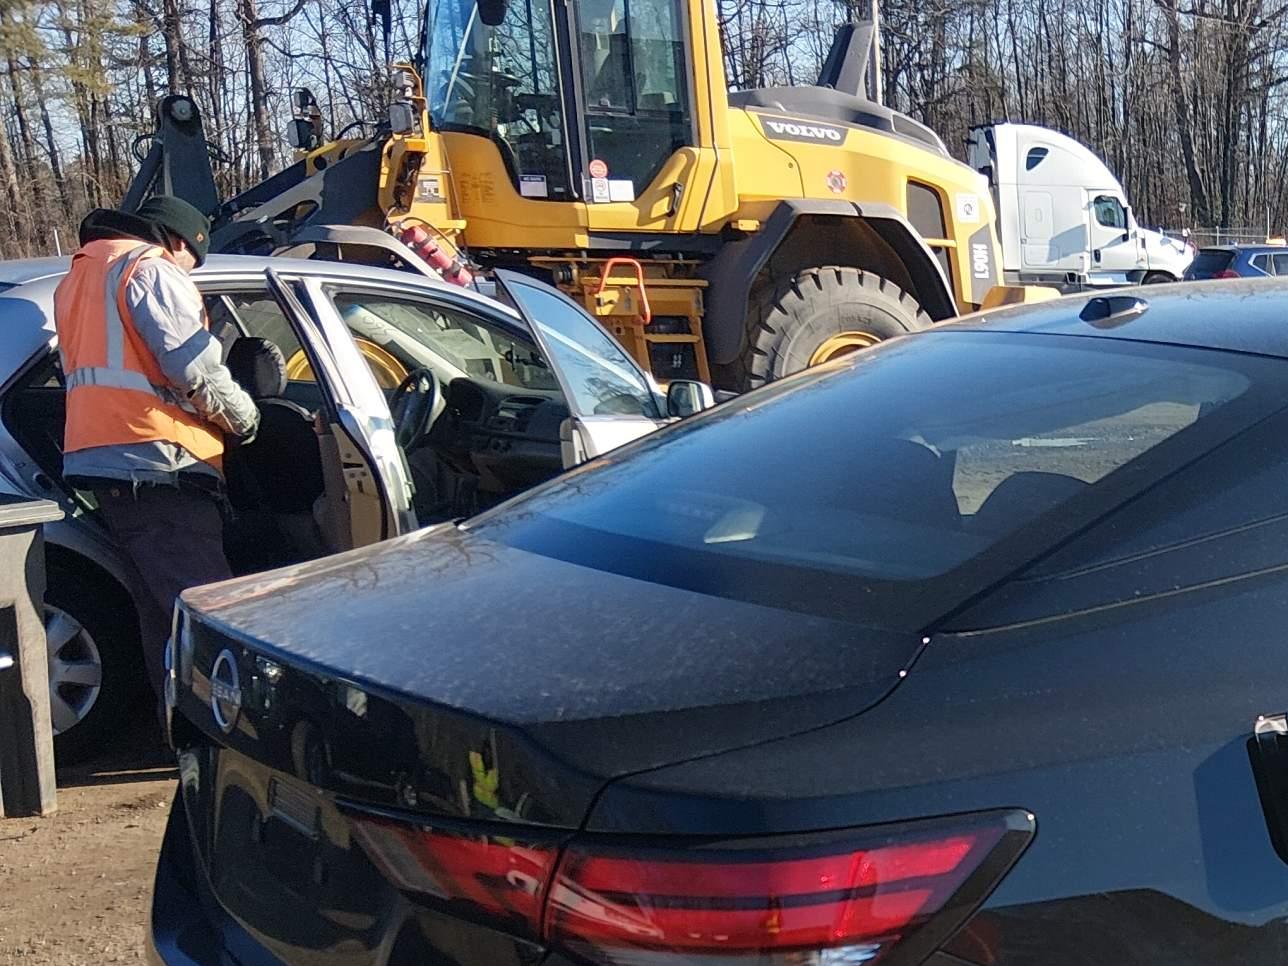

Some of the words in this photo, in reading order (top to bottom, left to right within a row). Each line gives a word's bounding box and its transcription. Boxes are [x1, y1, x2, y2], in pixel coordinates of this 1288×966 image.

[766, 121, 841, 140] VOLVO
[972, 243, 990, 279] L90H
[209, 680, 241, 705] SSAN
